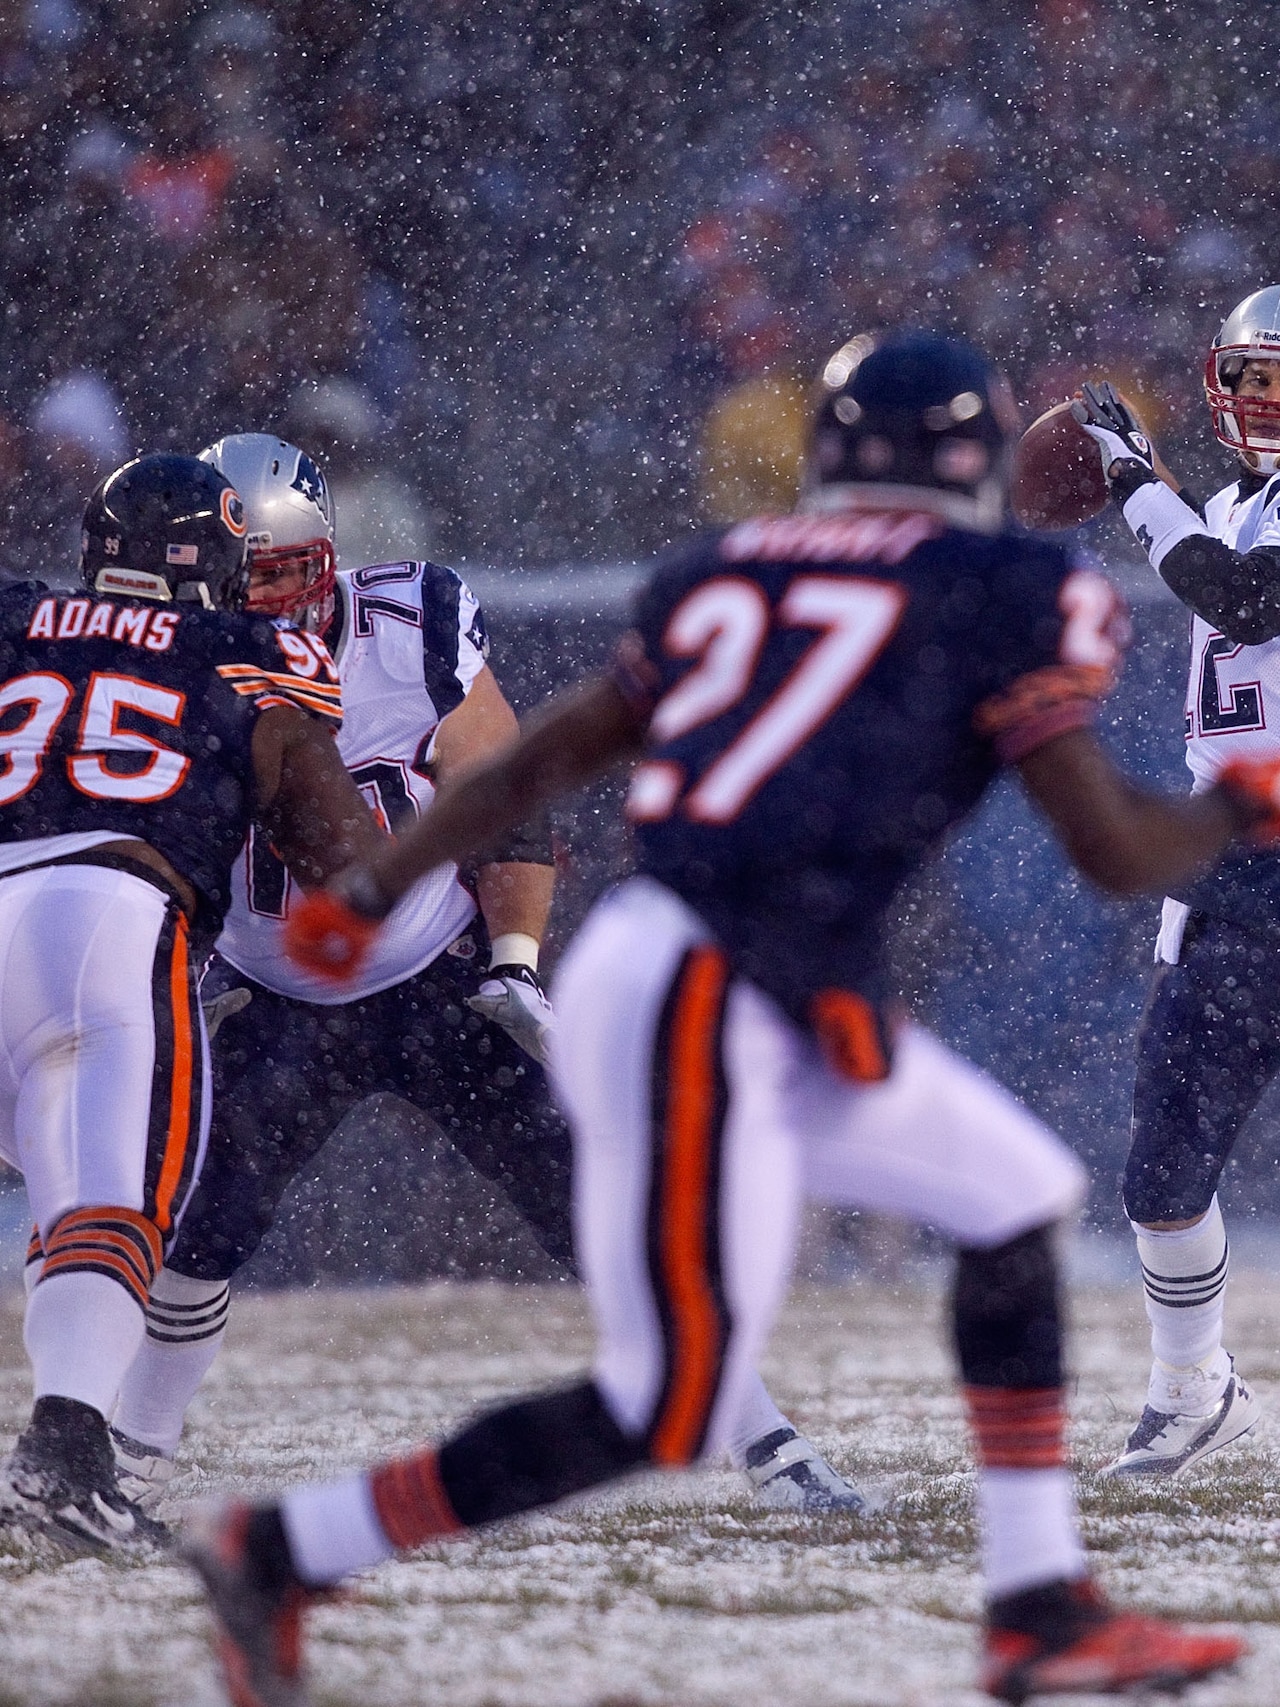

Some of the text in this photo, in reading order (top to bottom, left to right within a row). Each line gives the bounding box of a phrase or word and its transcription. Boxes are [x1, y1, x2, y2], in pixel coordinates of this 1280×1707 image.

[27, 597, 181, 651] ADAMS
[351, 560, 423, 638] 70
[0, 670, 192, 806] 95
[628, 573, 908, 827] 27
[1184, 631, 1267, 741] 2
